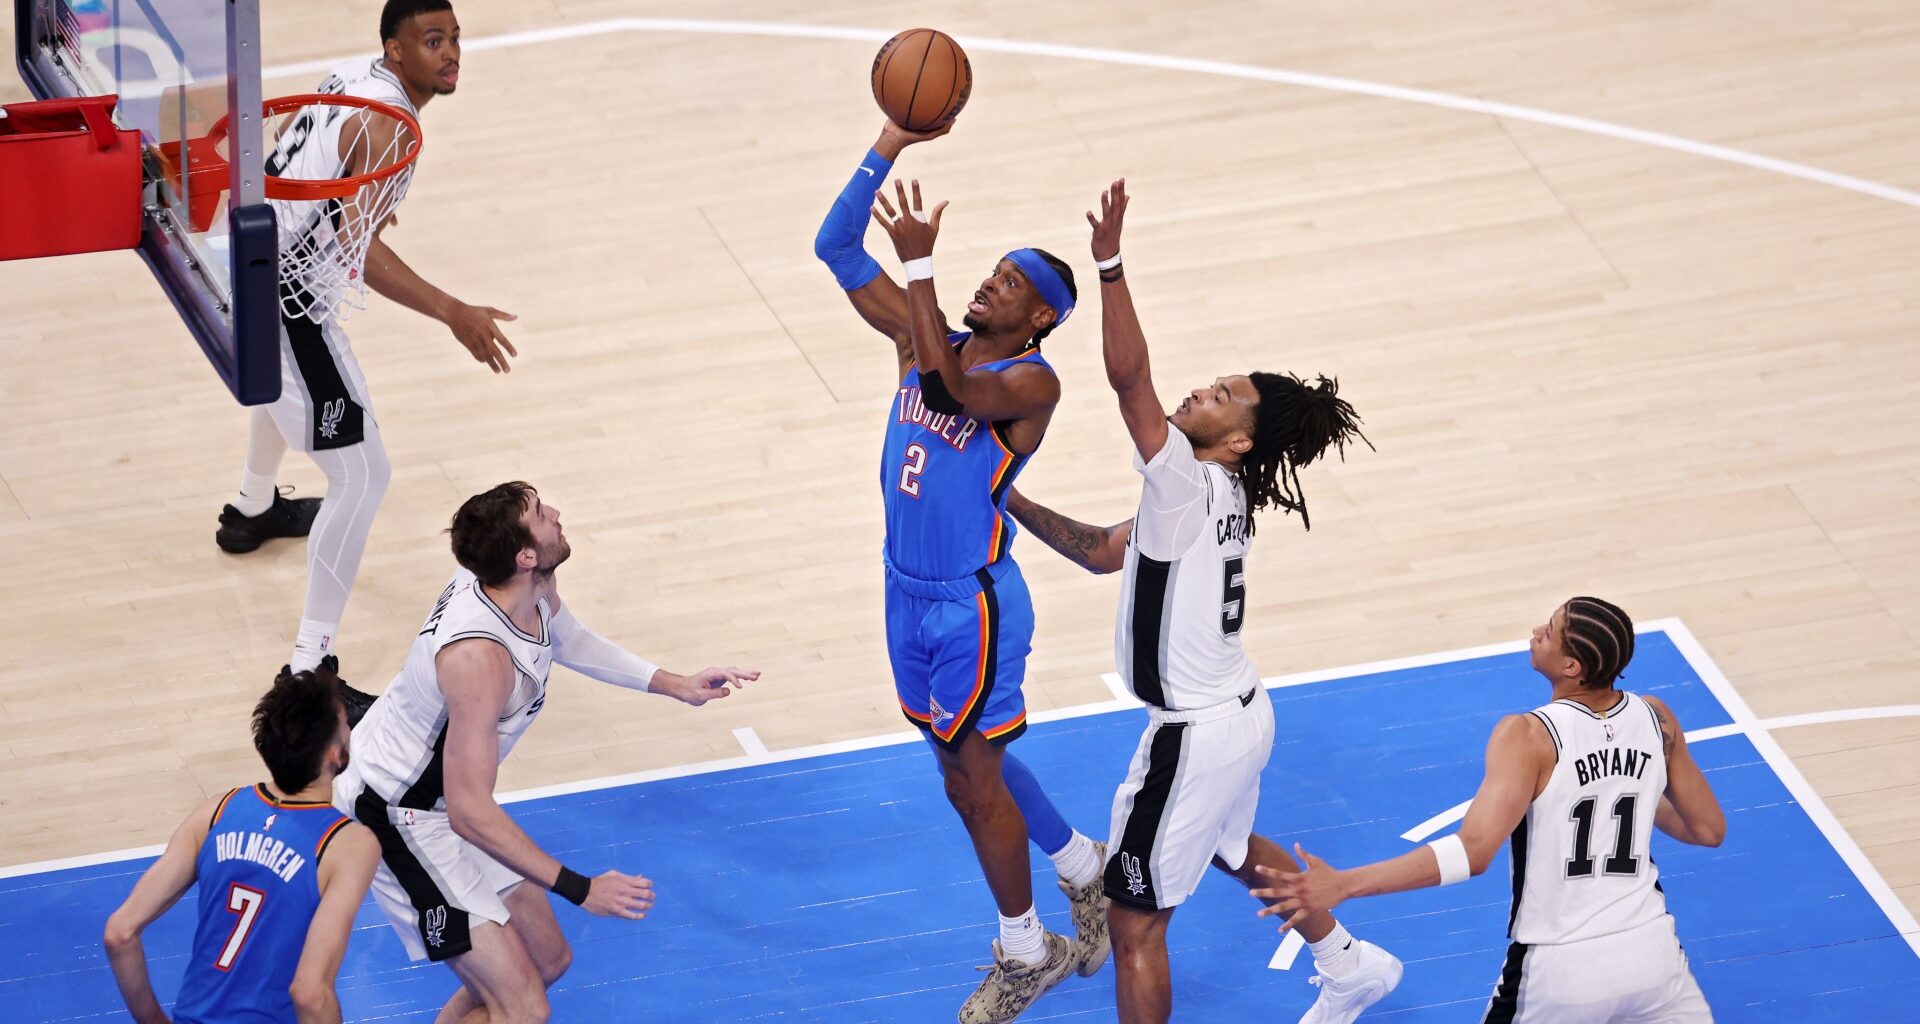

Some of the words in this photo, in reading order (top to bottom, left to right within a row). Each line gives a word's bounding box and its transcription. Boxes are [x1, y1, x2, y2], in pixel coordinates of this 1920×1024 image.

[263, 110, 316, 177] 3
[898, 442, 928, 498] 2
[1220, 554, 1246, 639] 5
[1574, 747, 1652, 787] BRYANT
[215, 831, 305, 883] HOLMGREN
[1564, 792, 1641, 880] 11
[213, 881, 267, 973] 7
